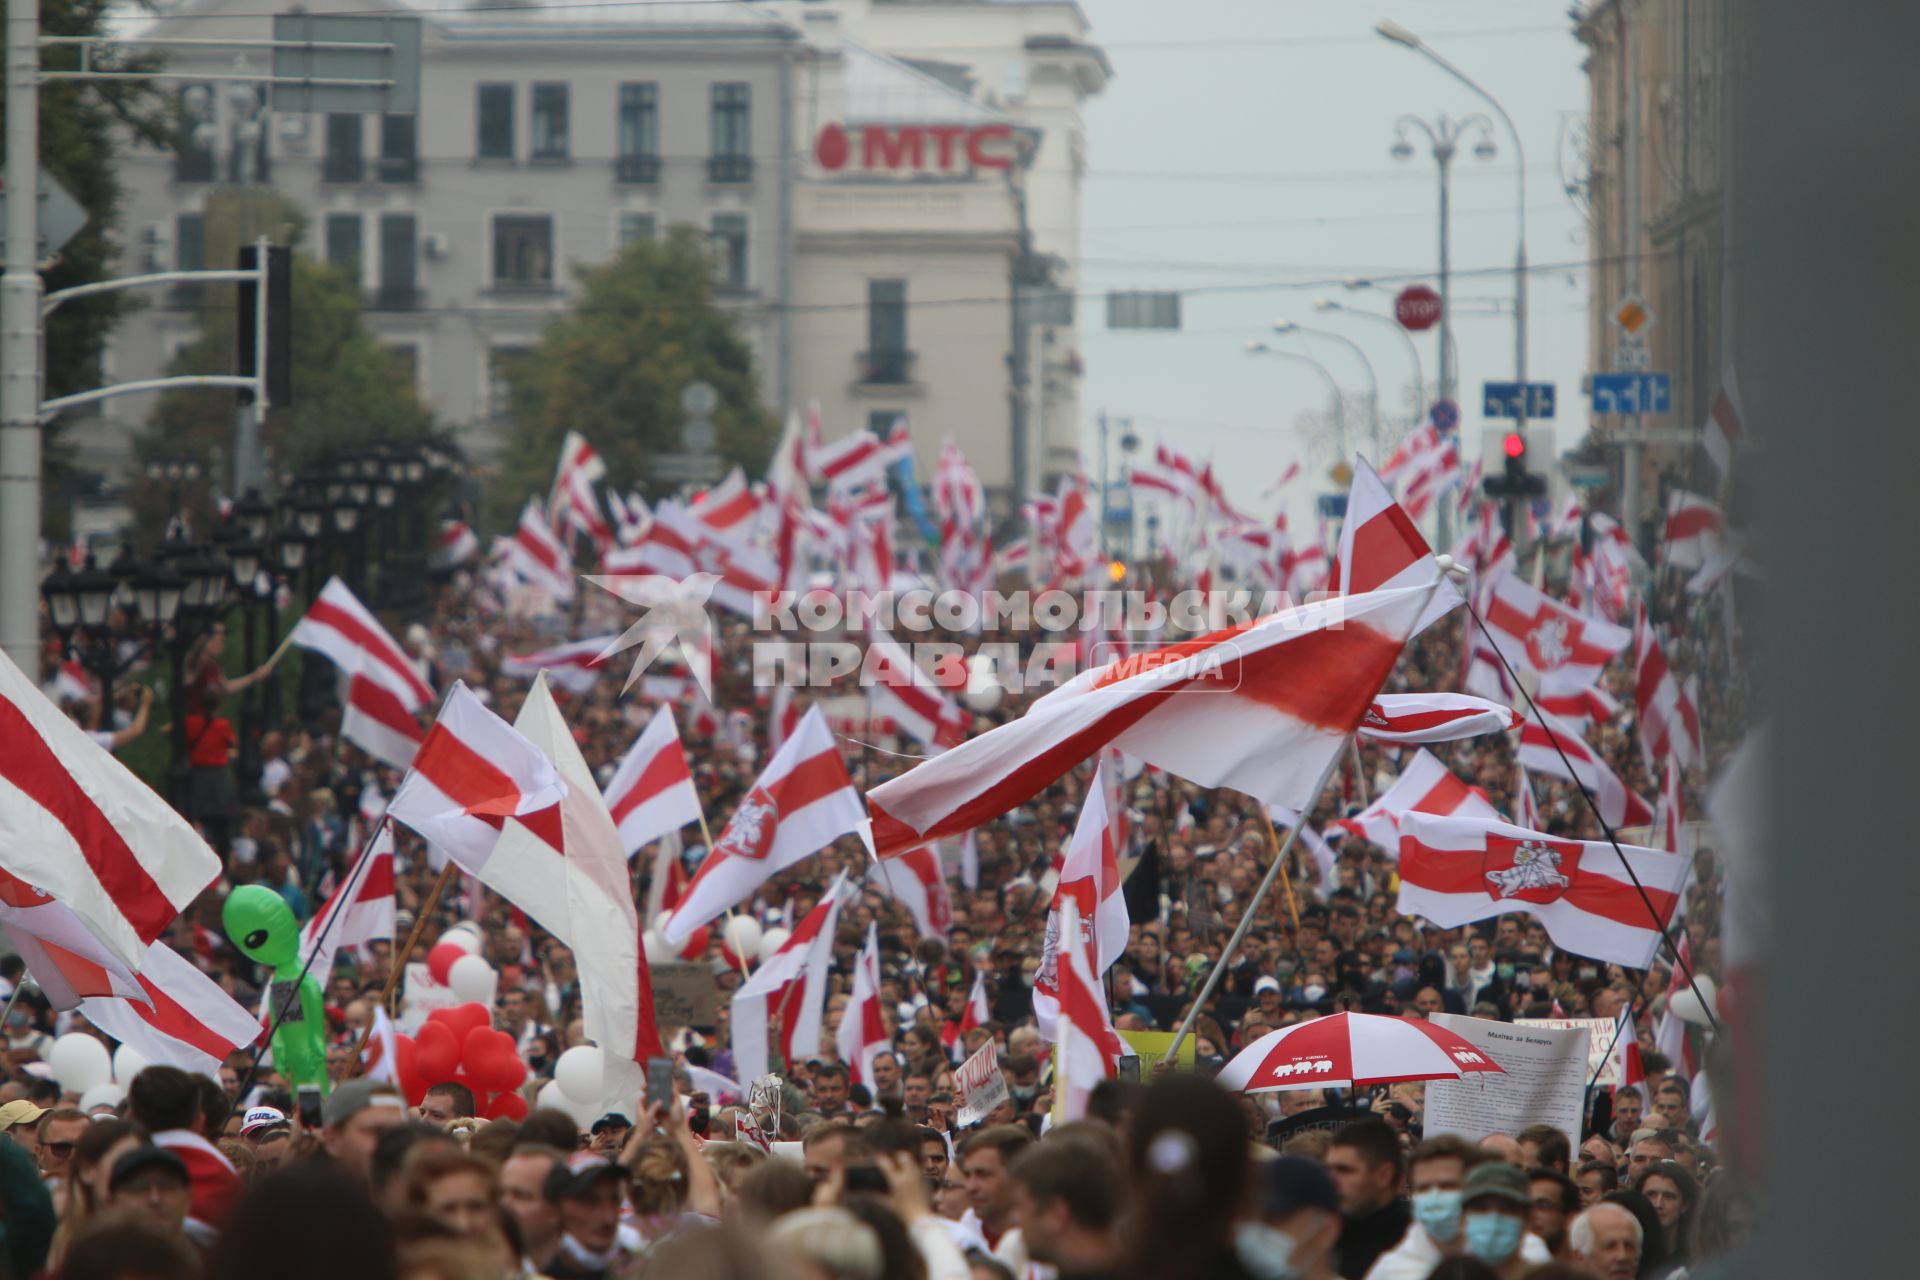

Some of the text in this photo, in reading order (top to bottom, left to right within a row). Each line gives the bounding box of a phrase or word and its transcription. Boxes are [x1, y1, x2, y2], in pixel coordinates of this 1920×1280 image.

[863, 124, 1013, 169] МТС
[1488, 1031, 1513, 1041] Малітва
[1526, 1036, 1552, 1046] Беларусь
